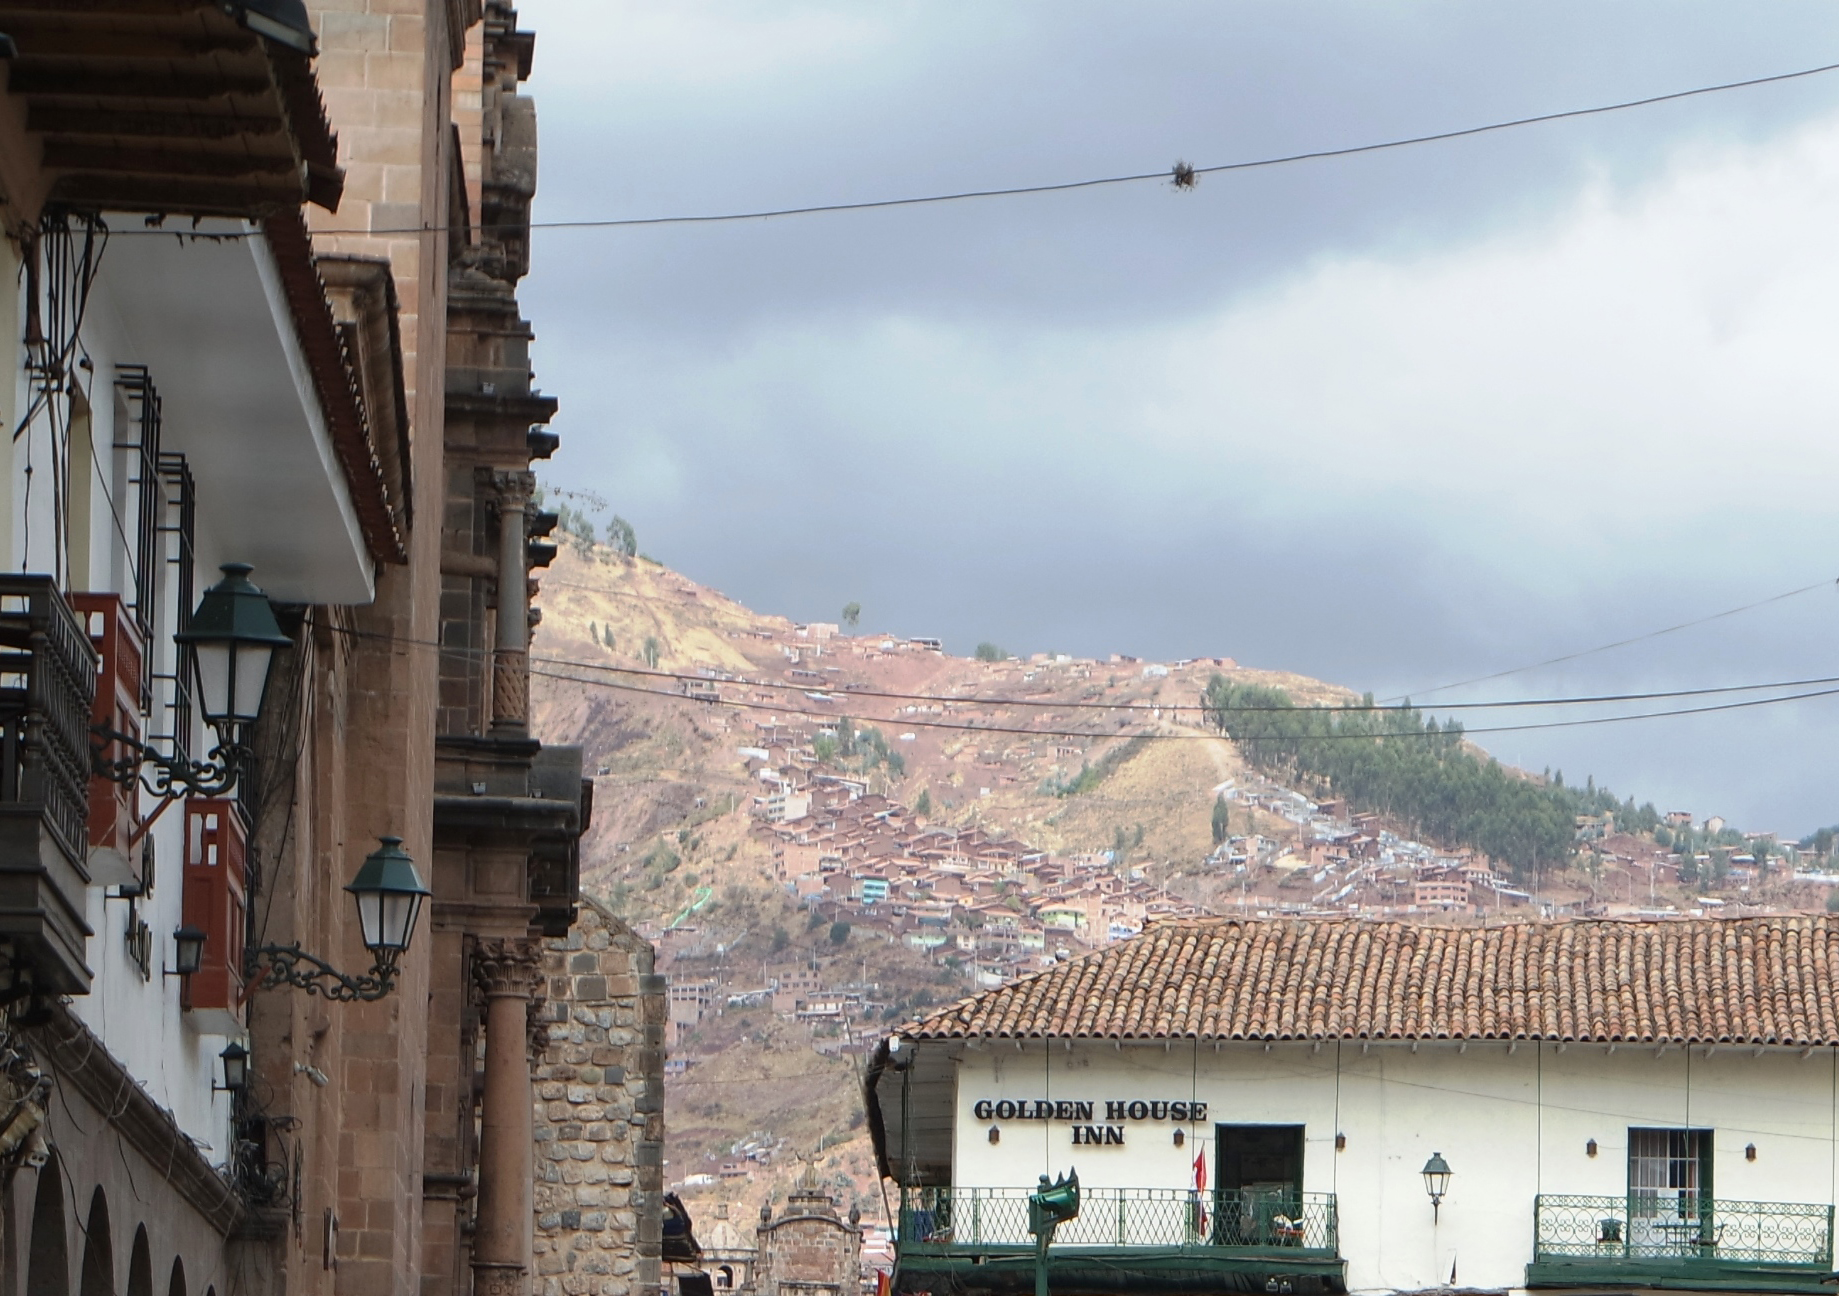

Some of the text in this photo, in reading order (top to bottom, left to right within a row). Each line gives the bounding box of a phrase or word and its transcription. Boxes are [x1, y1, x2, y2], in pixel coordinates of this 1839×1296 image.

[974, 1099, 1209, 1122] GOLDEN HOUSE
[1071, 1125, 1125, 1145] INN
